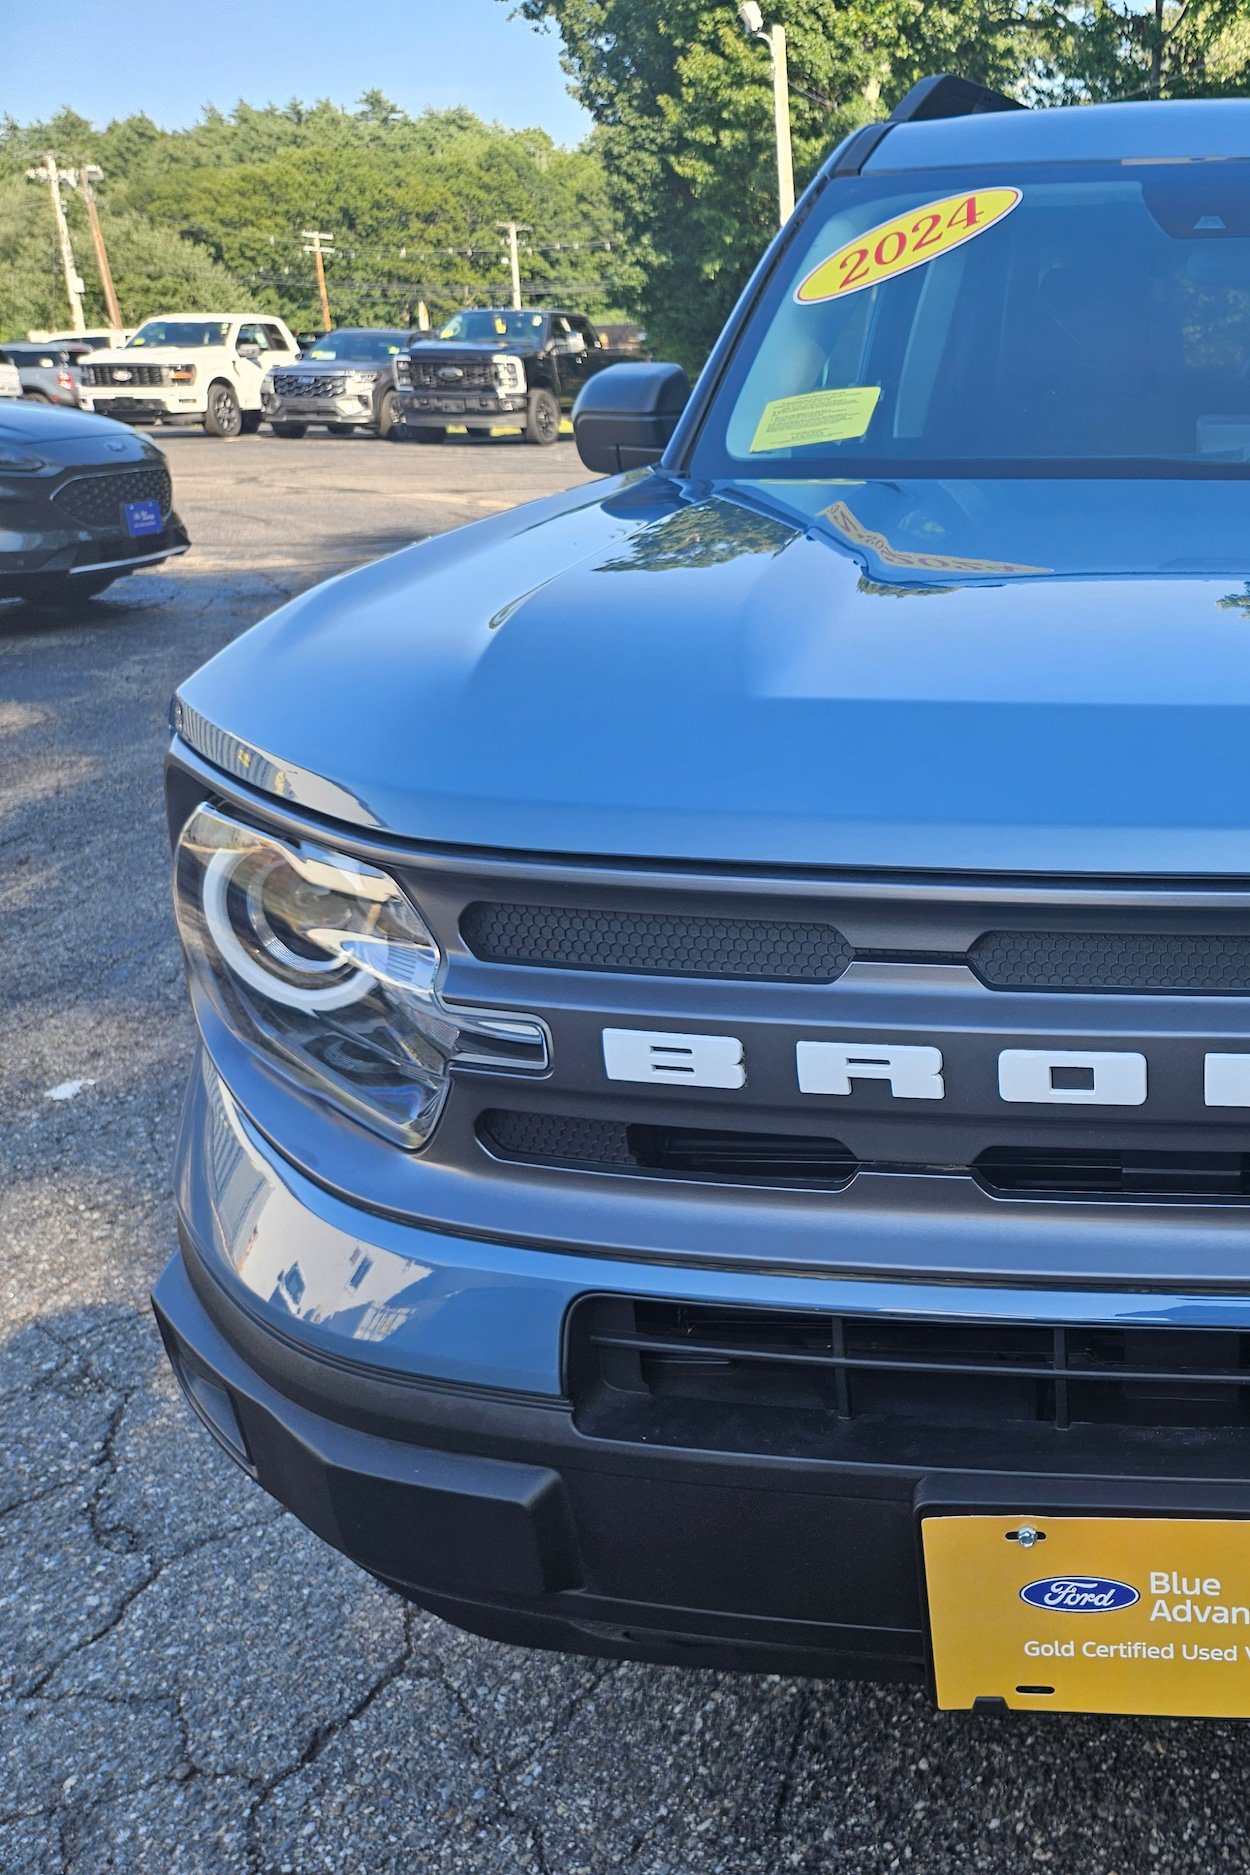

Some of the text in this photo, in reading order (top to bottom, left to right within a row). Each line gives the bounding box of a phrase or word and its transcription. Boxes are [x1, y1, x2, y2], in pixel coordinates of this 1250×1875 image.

[838, 196, 984, 290] 2024
[1042, 1580, 1117, 1608] Ford
[1149, 1571, 1221, 1597] Blue
[1023, 1640, 1075, 1659] Gold
[1082, 1641, 1175, 1661] Certified
[1181, 1645, 1238, 1663] Used
